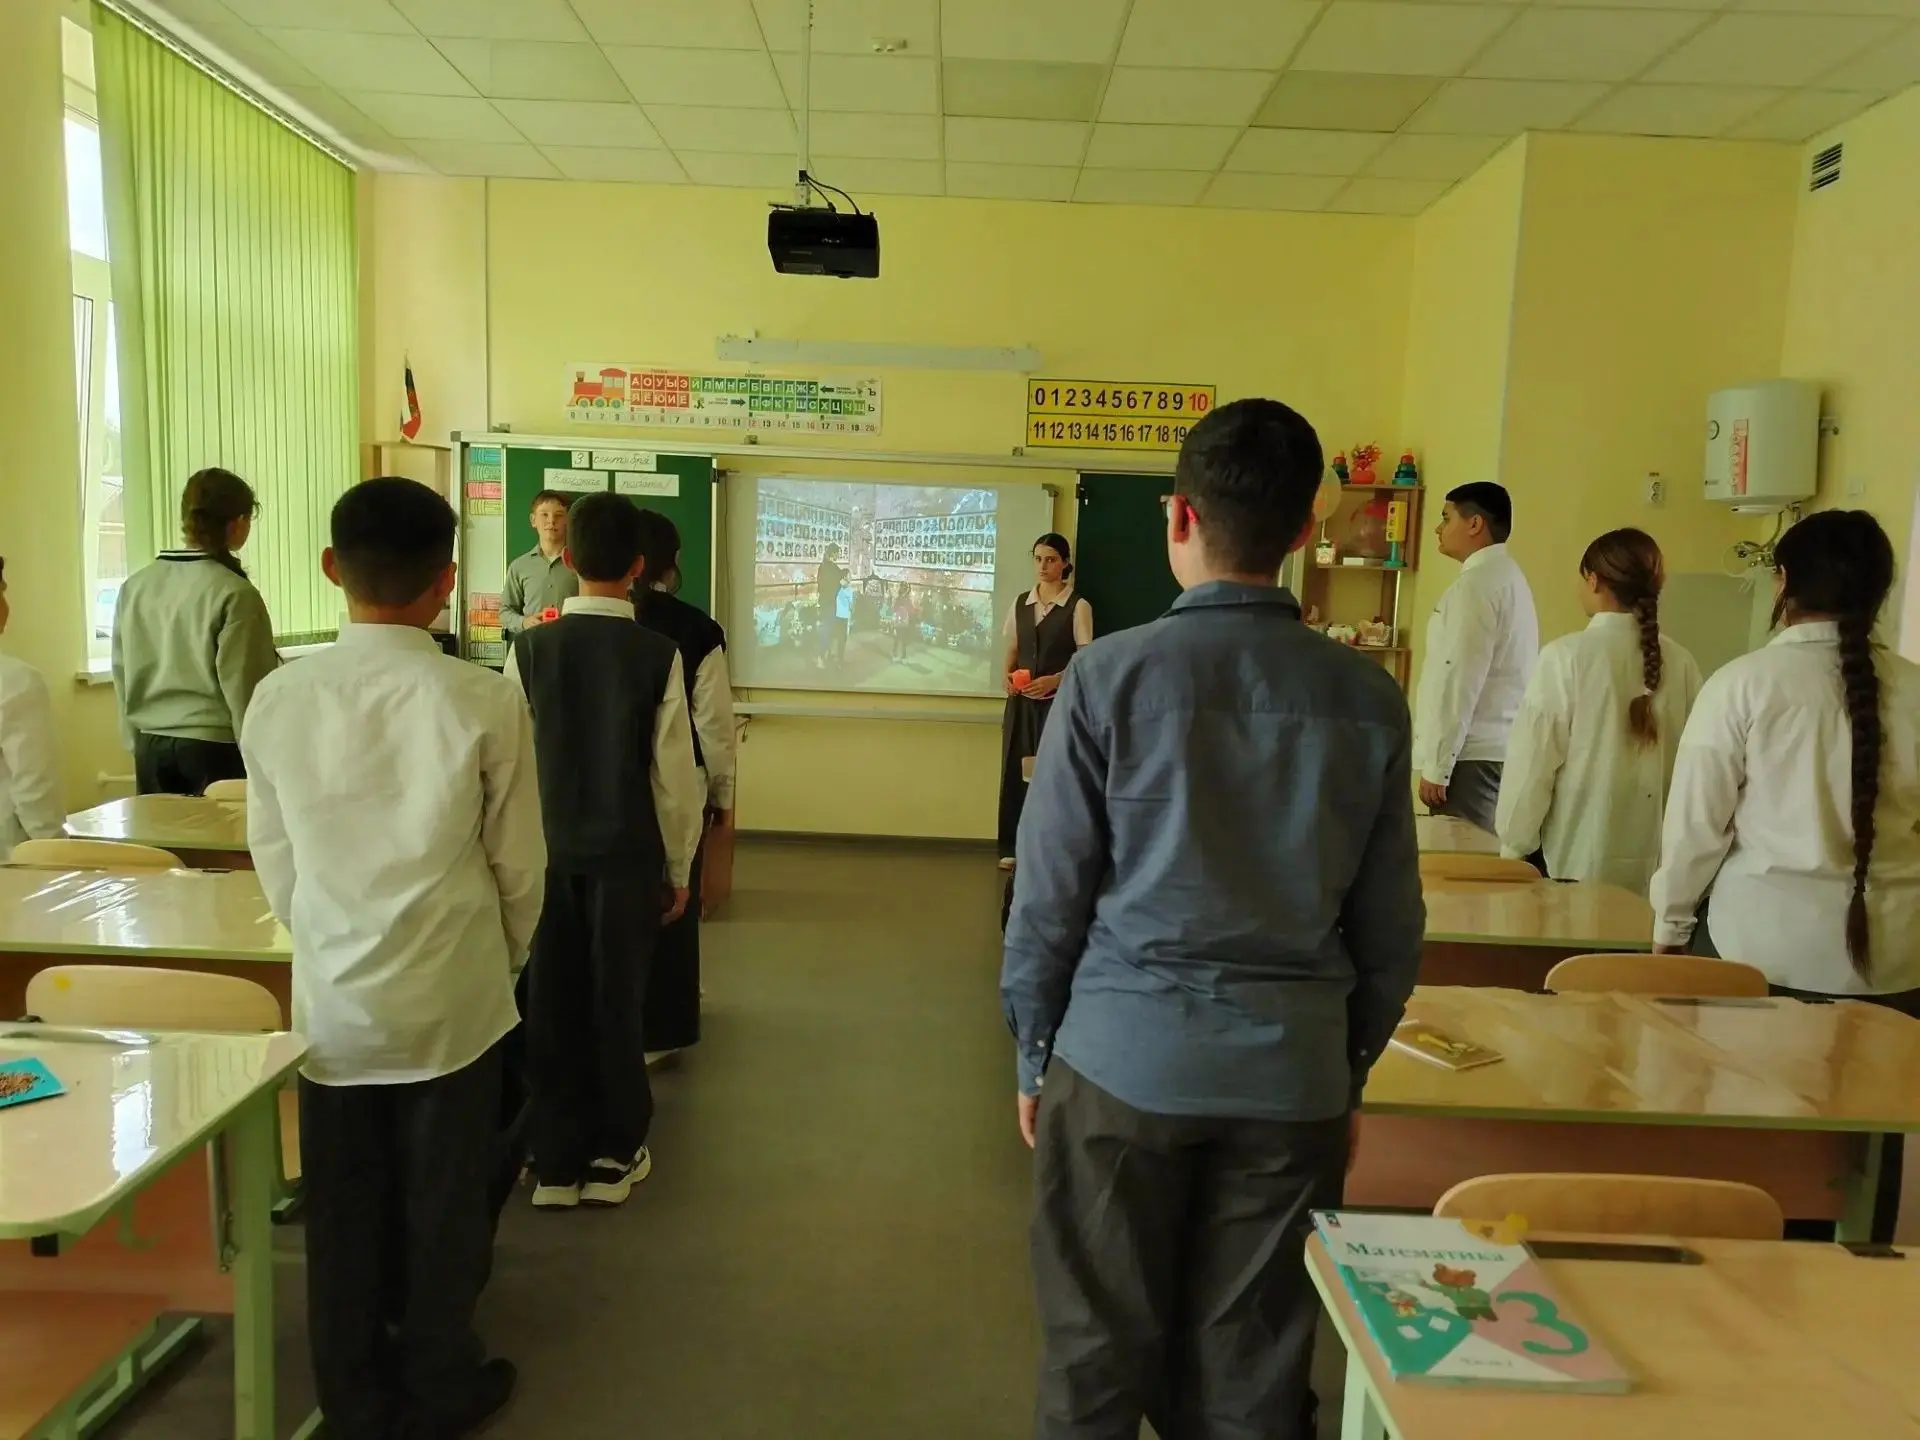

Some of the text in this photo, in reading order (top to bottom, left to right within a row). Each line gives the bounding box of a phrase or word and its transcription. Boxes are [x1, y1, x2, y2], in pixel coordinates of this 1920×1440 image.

[1035, 387, 1208, 411] 0 1 2 3 4 5 6 7 8 9 10
[1033, 421, 1187, 443] 11 12 13 14 15 16 17 18 19
[1346, 1242, 1505, 1262] Математика
[1496, 1290, 1589, 1357] 3
